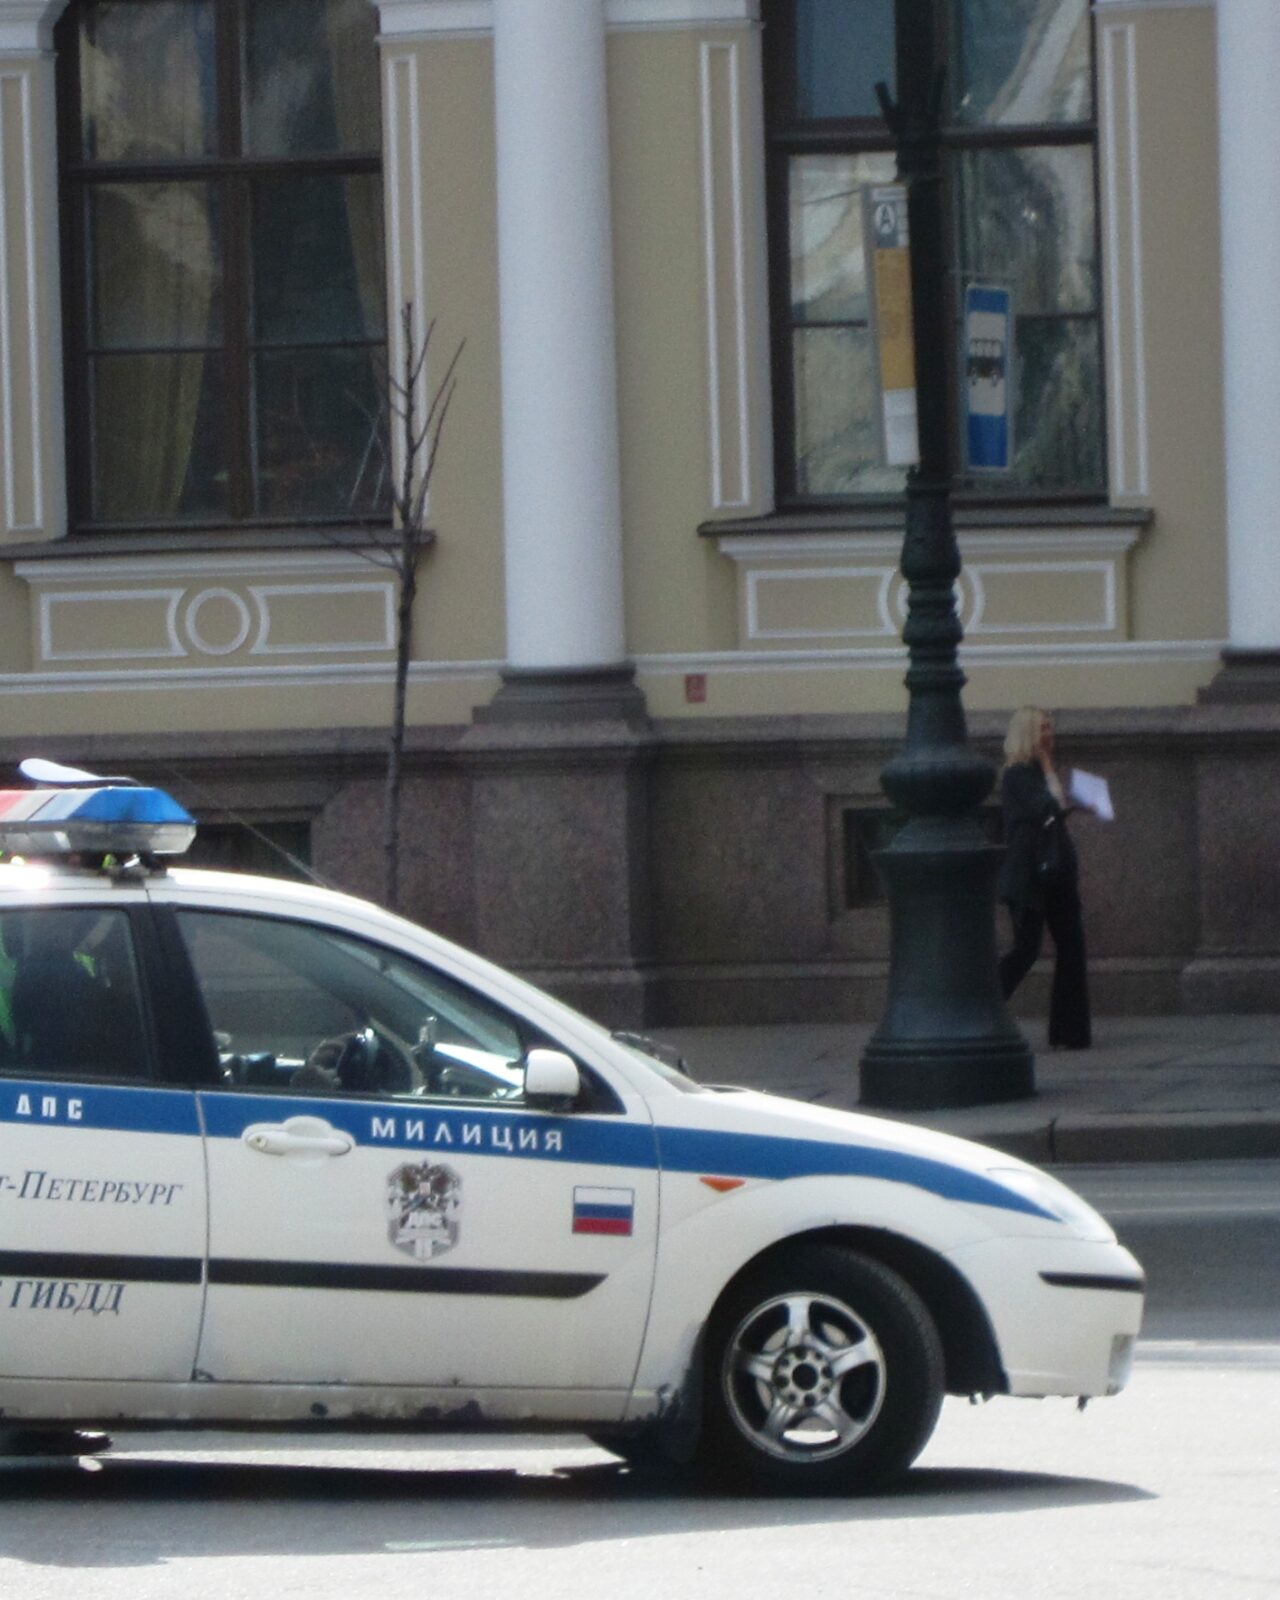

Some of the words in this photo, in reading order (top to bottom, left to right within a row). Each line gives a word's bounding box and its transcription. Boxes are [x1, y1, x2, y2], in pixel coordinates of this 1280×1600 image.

[15, 1093, 83, 1120] ДПС
[371, 1116, 564, 1152] МИЛИЦИЯ
[9, 1279, 127, 1318] ГИБДД
